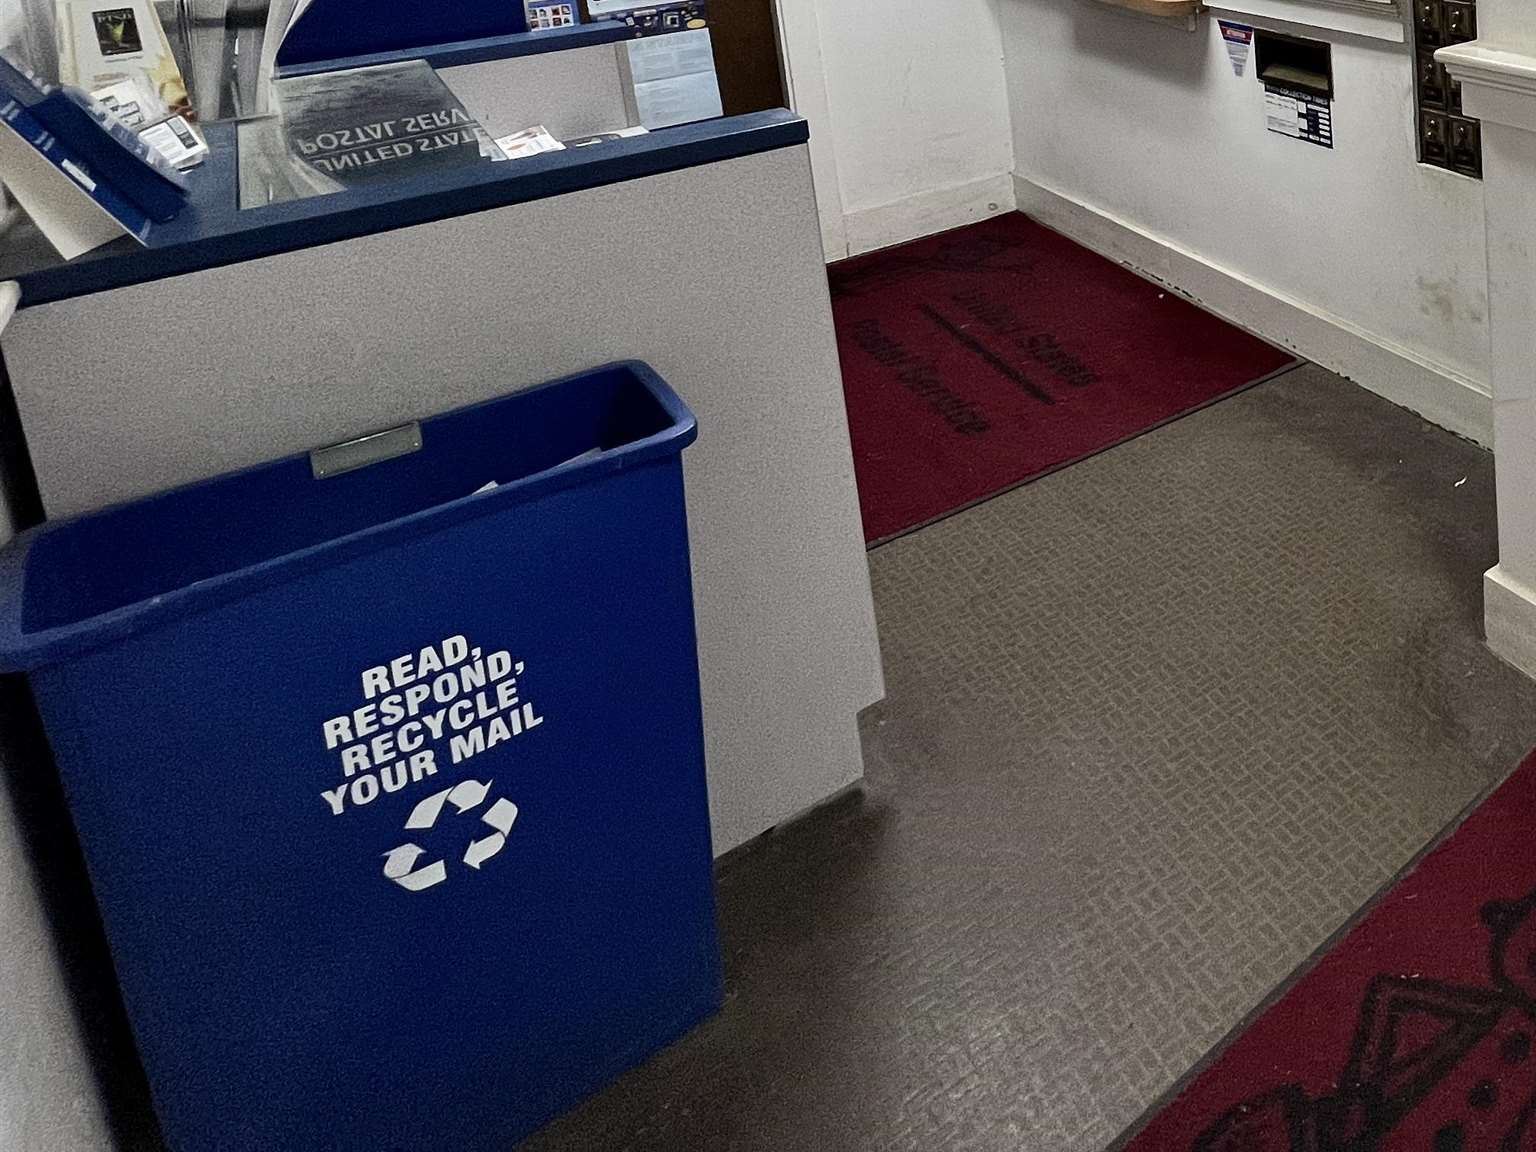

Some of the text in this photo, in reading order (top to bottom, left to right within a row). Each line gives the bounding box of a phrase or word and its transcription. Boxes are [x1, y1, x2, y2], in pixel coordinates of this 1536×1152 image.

[323, 650, 525, 749] RESPOND,
[361, 635, 481, 699] READ,
[321, 702, 544, 815] YOUR MAIL
[341, 678, 519, 777] RECYCLE
